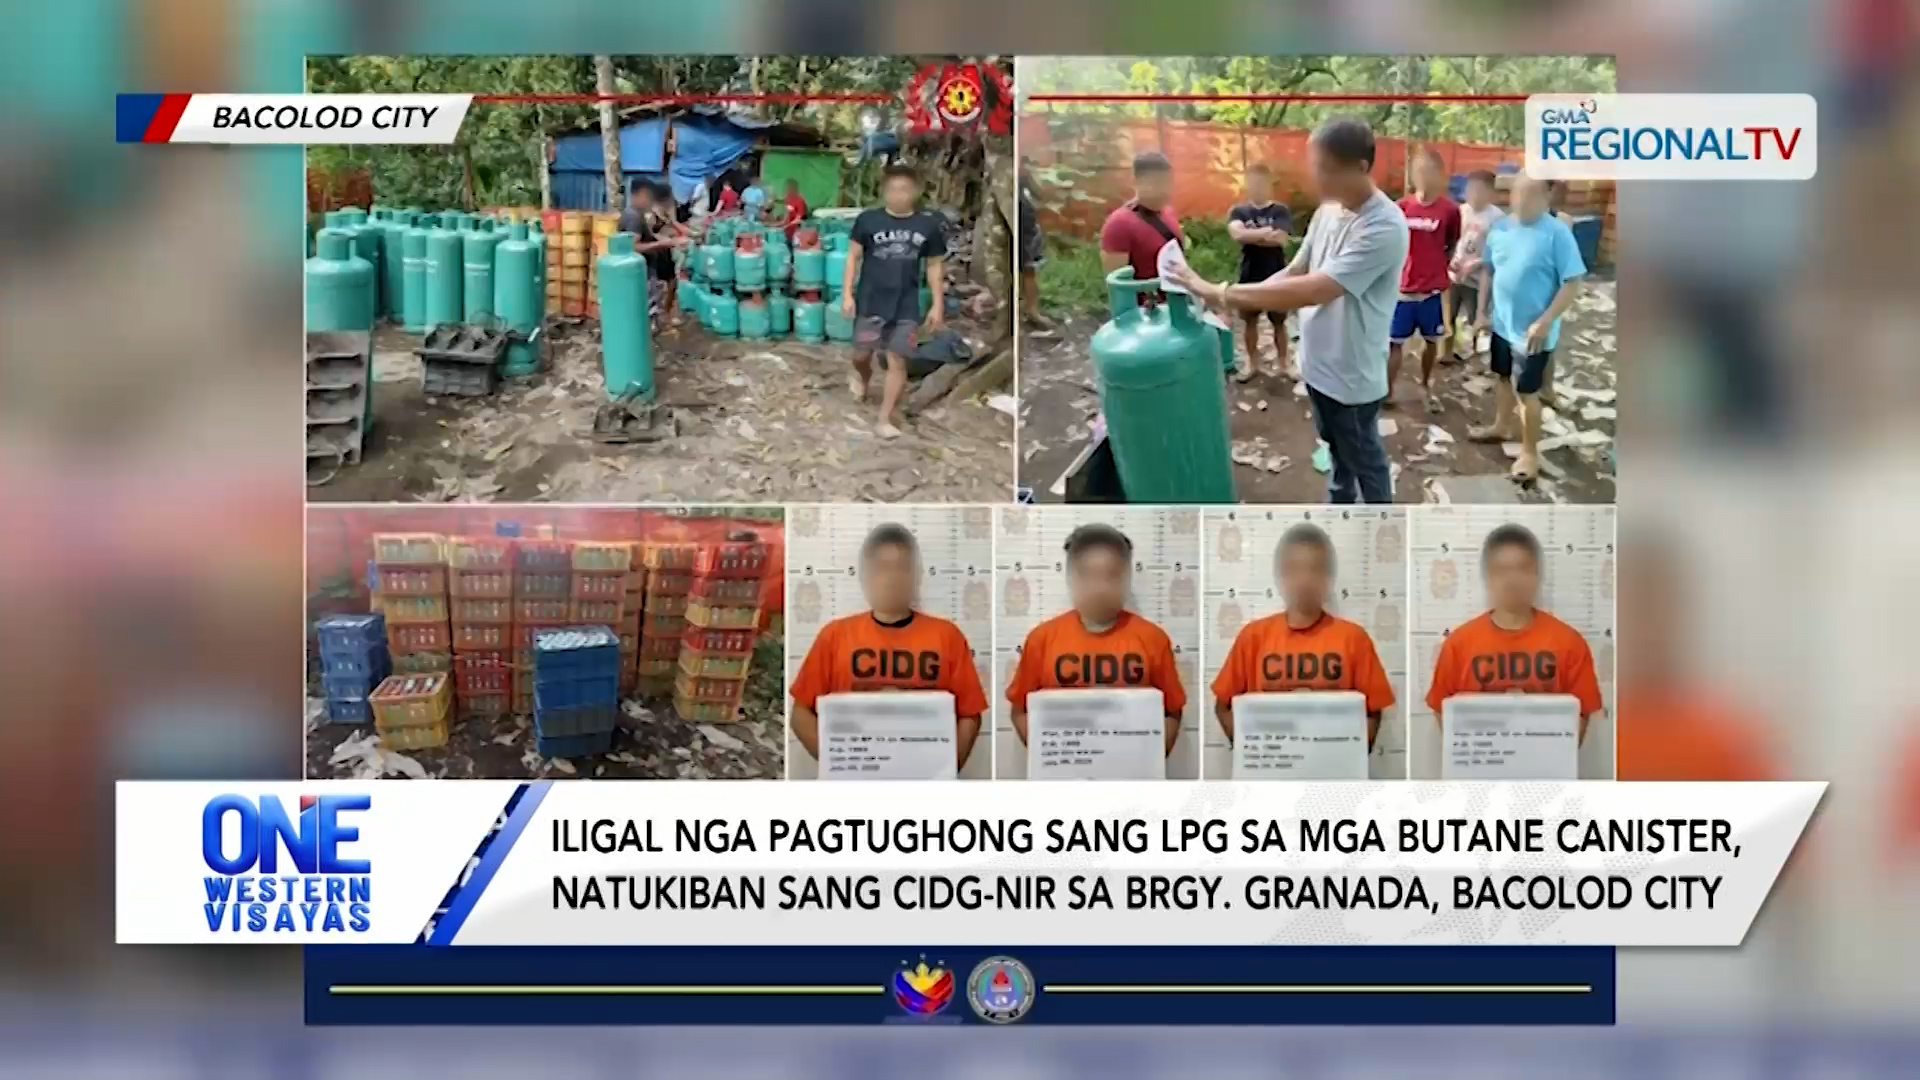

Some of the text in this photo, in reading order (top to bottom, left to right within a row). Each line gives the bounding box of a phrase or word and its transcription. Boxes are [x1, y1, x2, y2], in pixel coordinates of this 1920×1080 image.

[852, 647, 940, 681] CIDG
[1055, 652, 1144, 685] CIDG
[1262, 652, 1342, 681] CIDG
[1472, 650, 1557, 684] CIDG
